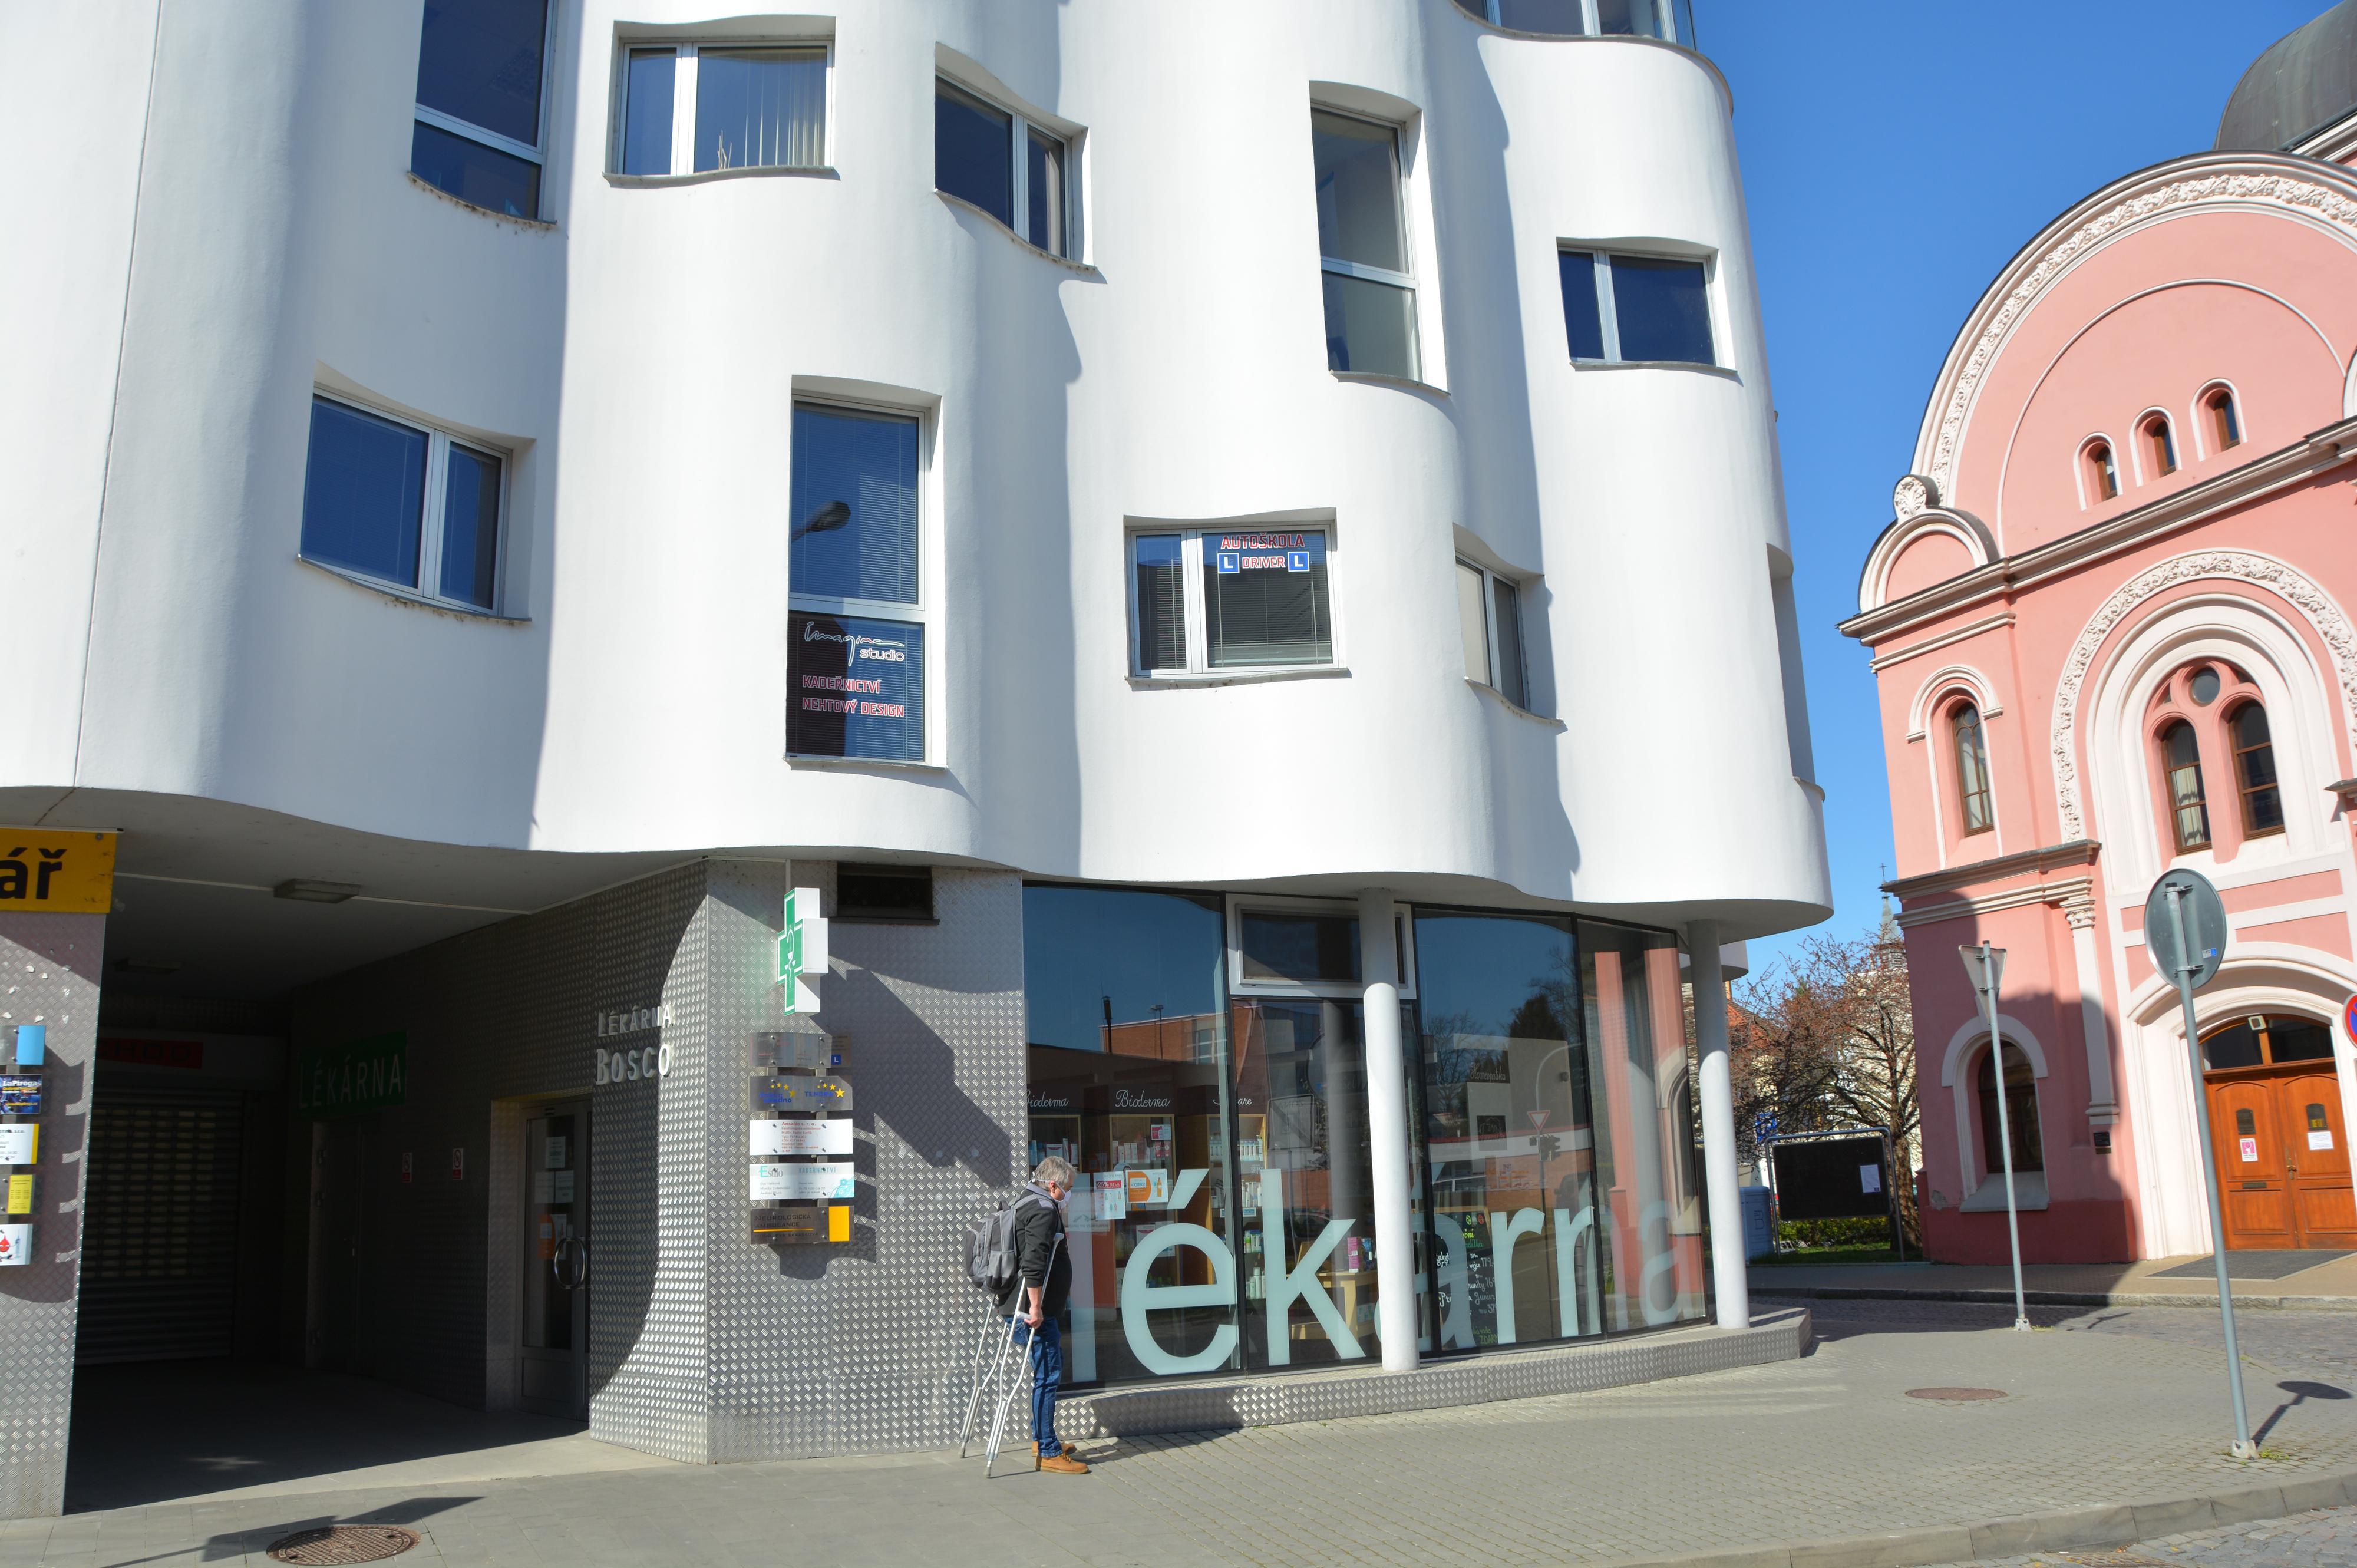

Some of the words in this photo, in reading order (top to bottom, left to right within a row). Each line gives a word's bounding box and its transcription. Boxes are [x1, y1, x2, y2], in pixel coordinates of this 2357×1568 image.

[1220, 532, 1306, 550] AUTOŠKOLA
[1224, 556, 1234, 569] L
[1242, 556, 1286, 569] DRIVER
[1294, 555, 1304, 567] L
[859, 648, 905, 662] studio
[802, 675, 882, 694] KADEŘNICTVÍ
[802, 697, 858, 714] NEHTOVÝ
[861, 702, 904, 717] DESIGN
[597, 1004, 672, 1037] LÉKÁRNA
[596, 1044, 672, 1085] BOSCO
[298, 1053, 403, 1109] LÉKÁRNA
[1115, 1089, 1171, 1107] Bioderma
